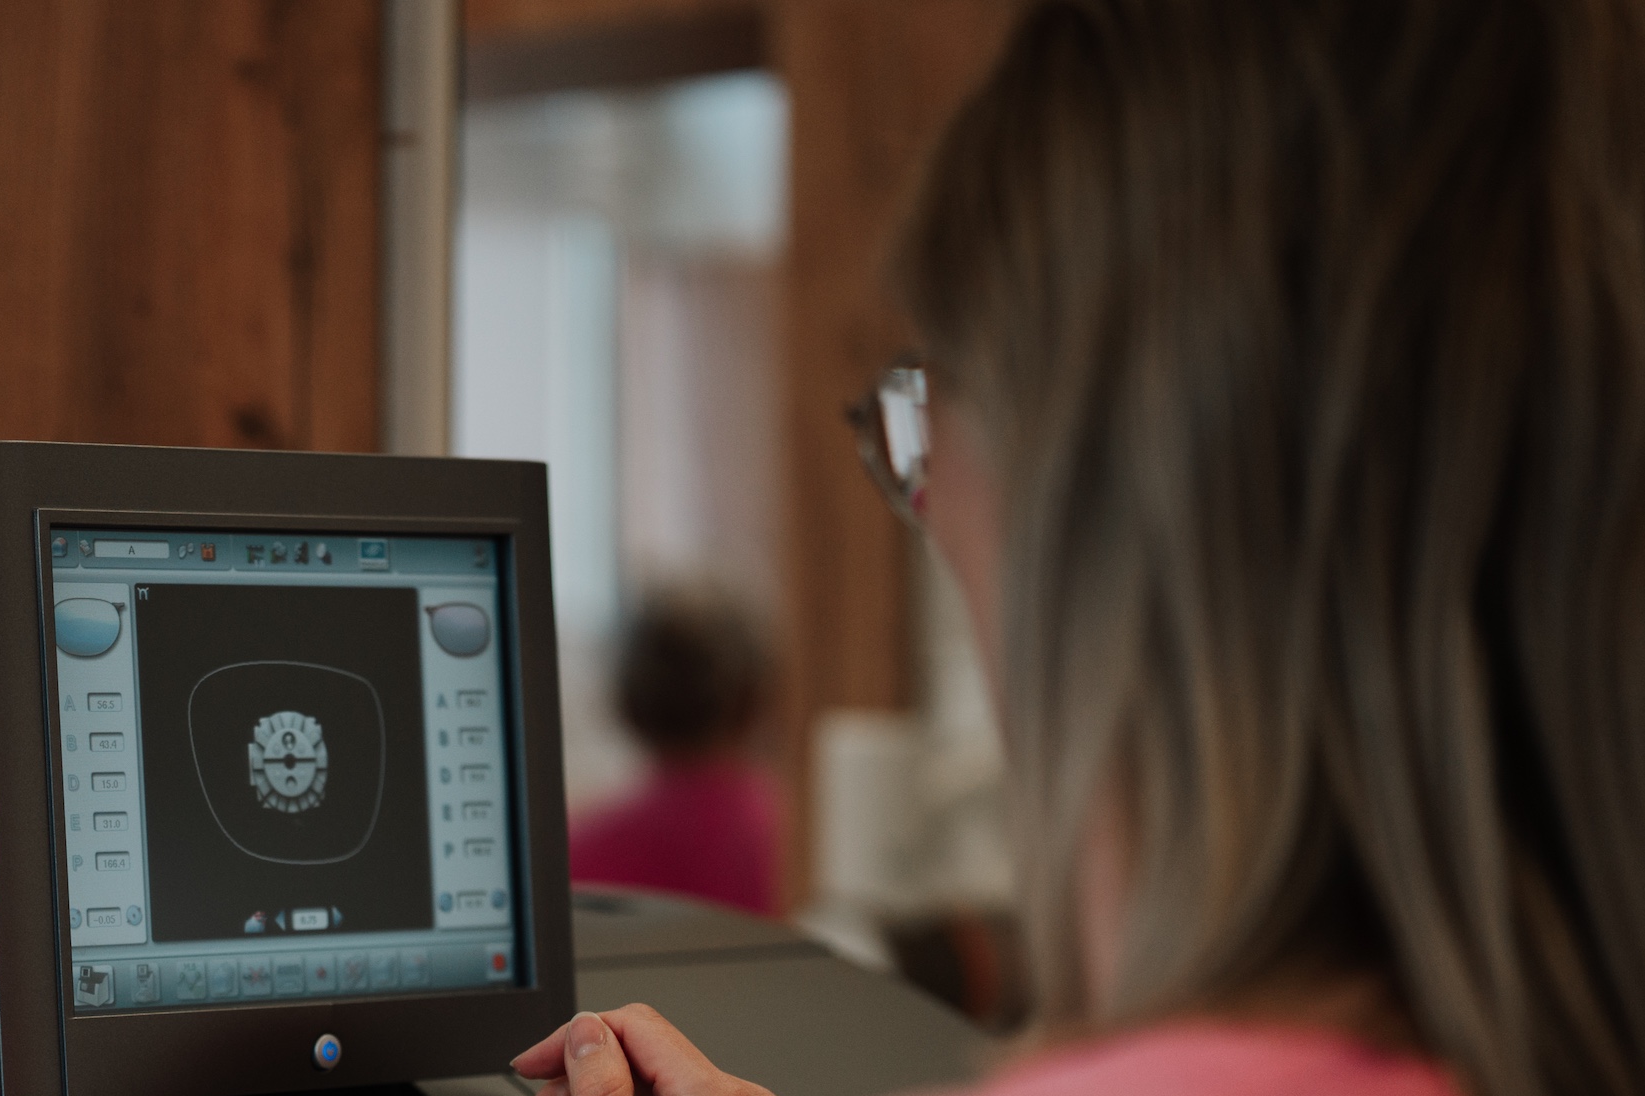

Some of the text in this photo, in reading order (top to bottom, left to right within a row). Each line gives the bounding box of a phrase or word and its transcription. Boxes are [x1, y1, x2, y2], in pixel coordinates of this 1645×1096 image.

[128, 545, 136, 555] A
[63, 694, 115, 711] A 56.5
[65, 734, 117, 752] B 43.4
[67, 774, 119, 792] D 15.0
[70, 813, 121, 831] E 31.0
[72, 854, 125, 872] P 166.4
